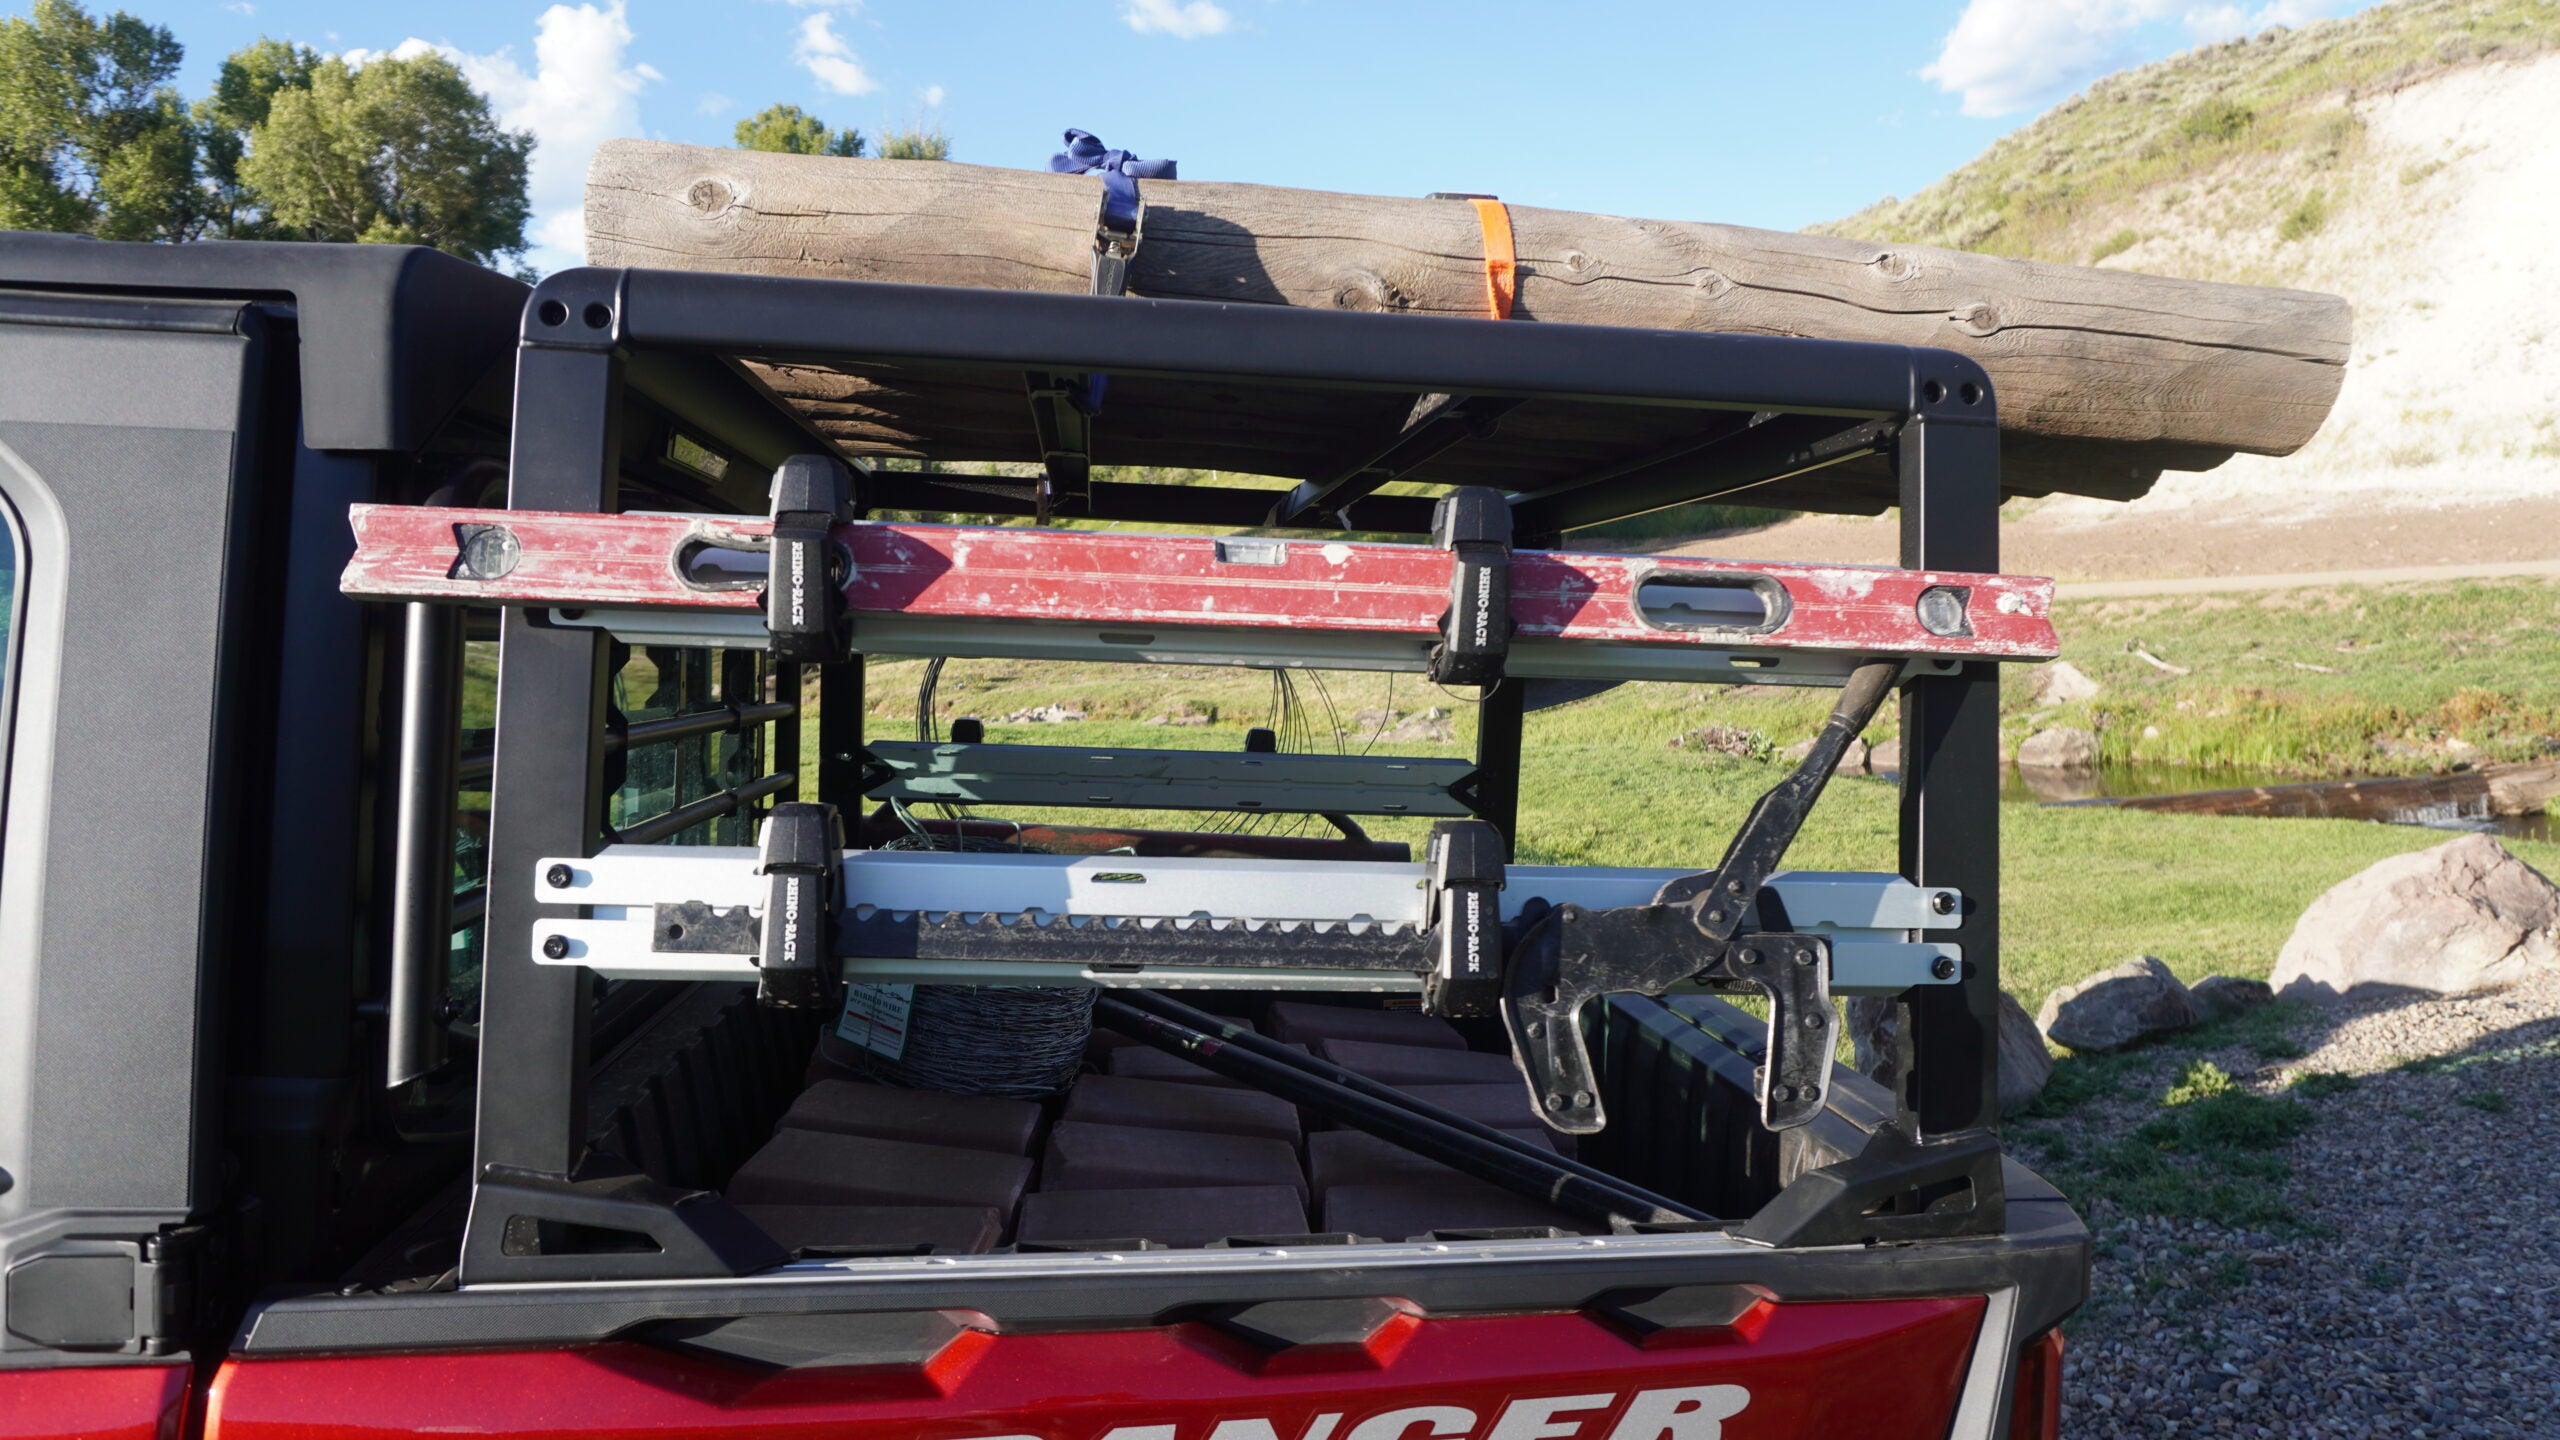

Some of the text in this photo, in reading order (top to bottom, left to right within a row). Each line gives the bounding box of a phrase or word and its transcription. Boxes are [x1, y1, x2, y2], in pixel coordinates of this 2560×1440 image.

[792, 541, 804, 626] RHINO-RACK
[1475, 566, 1492, 647] RHINO-RACK
[783, 877, 799, 962] RHINO-RACK
[1467, 891, 1480, 973] RHINO-RACK
